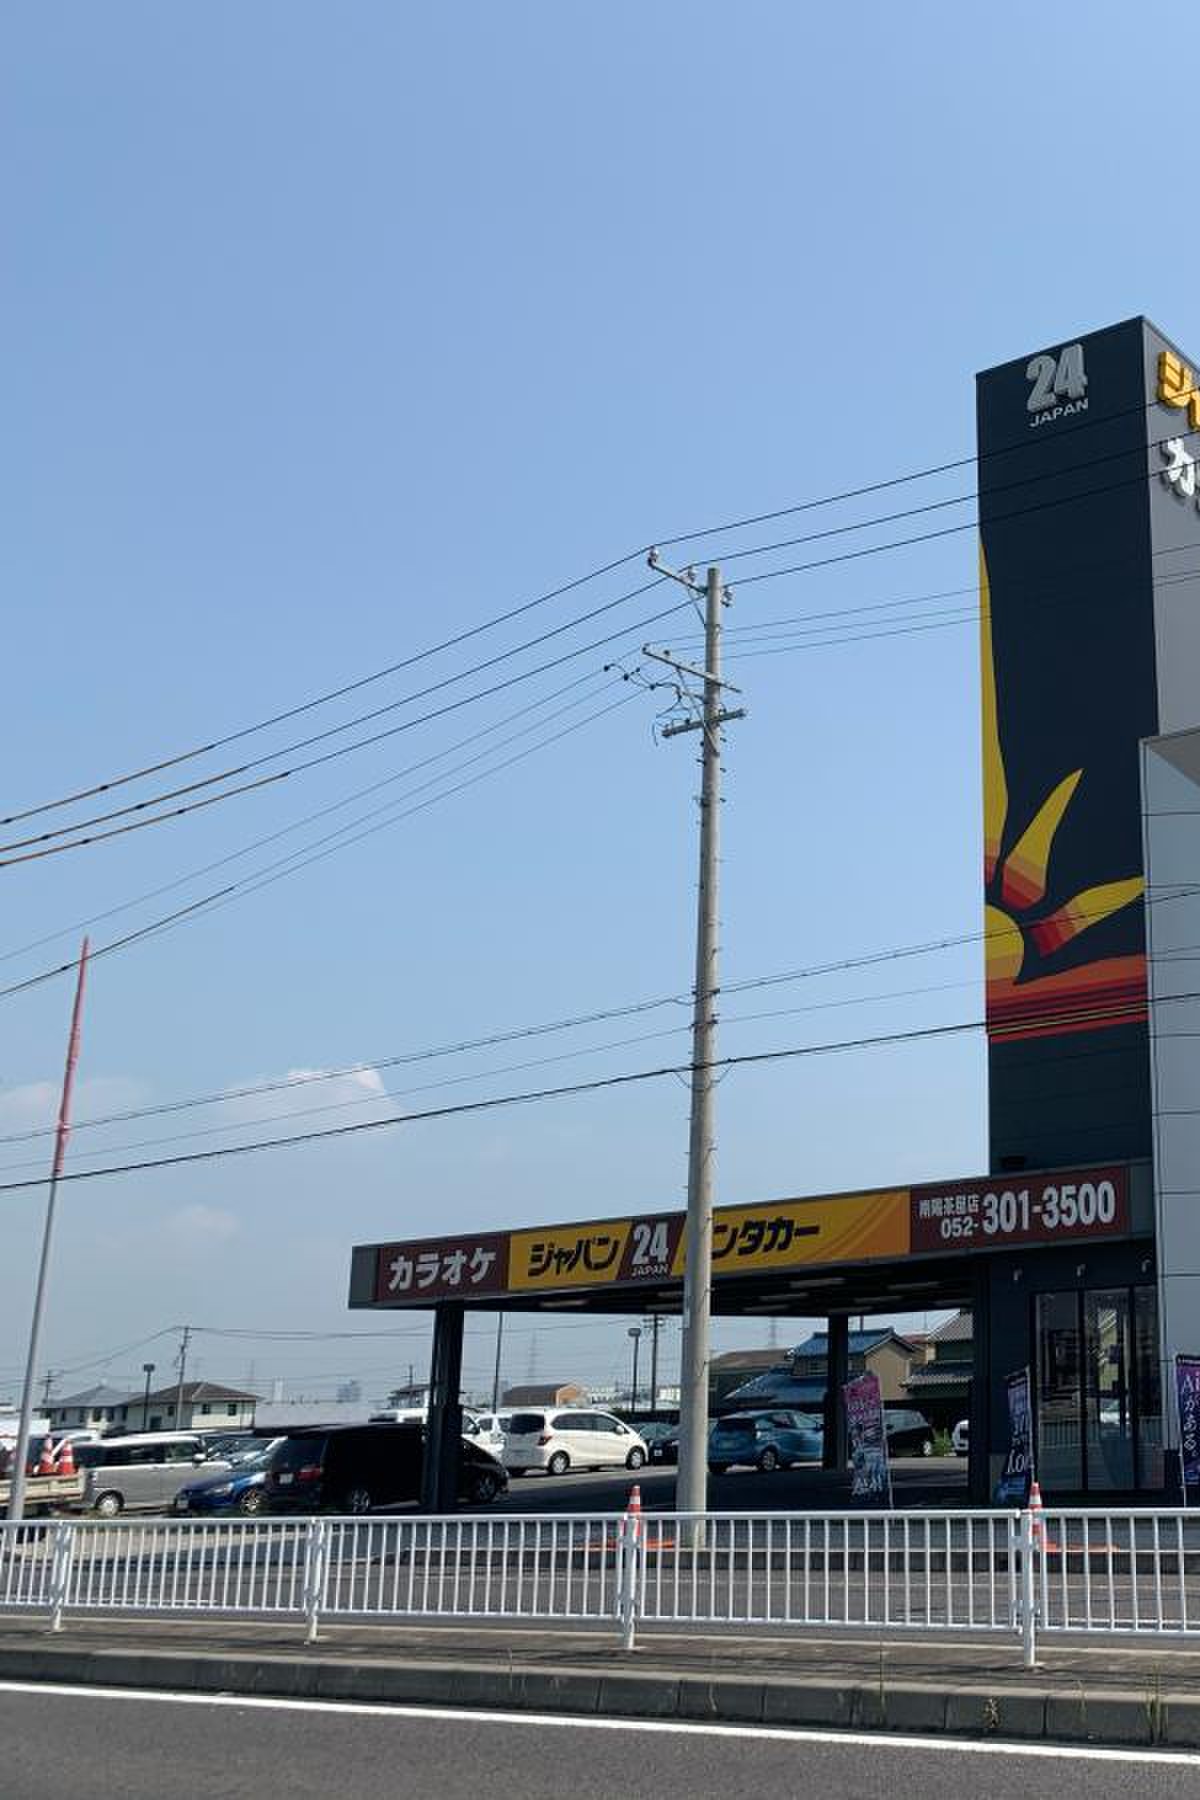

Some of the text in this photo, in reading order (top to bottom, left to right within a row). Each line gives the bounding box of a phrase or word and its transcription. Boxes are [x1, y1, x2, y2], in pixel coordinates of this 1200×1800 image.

[1025, 343, 1088, 412] 24
[1029, 399, 1089, 427] JAPAN
[527, 1237, 620, 1277] ジャパン
[633, 1221, 669, 1265] 24
[692, 1216, 820, 1261] ンタカー
[388, 1247, 496, 1290] カラオケ
[631, 1262, 669, 1277] JAPAN
